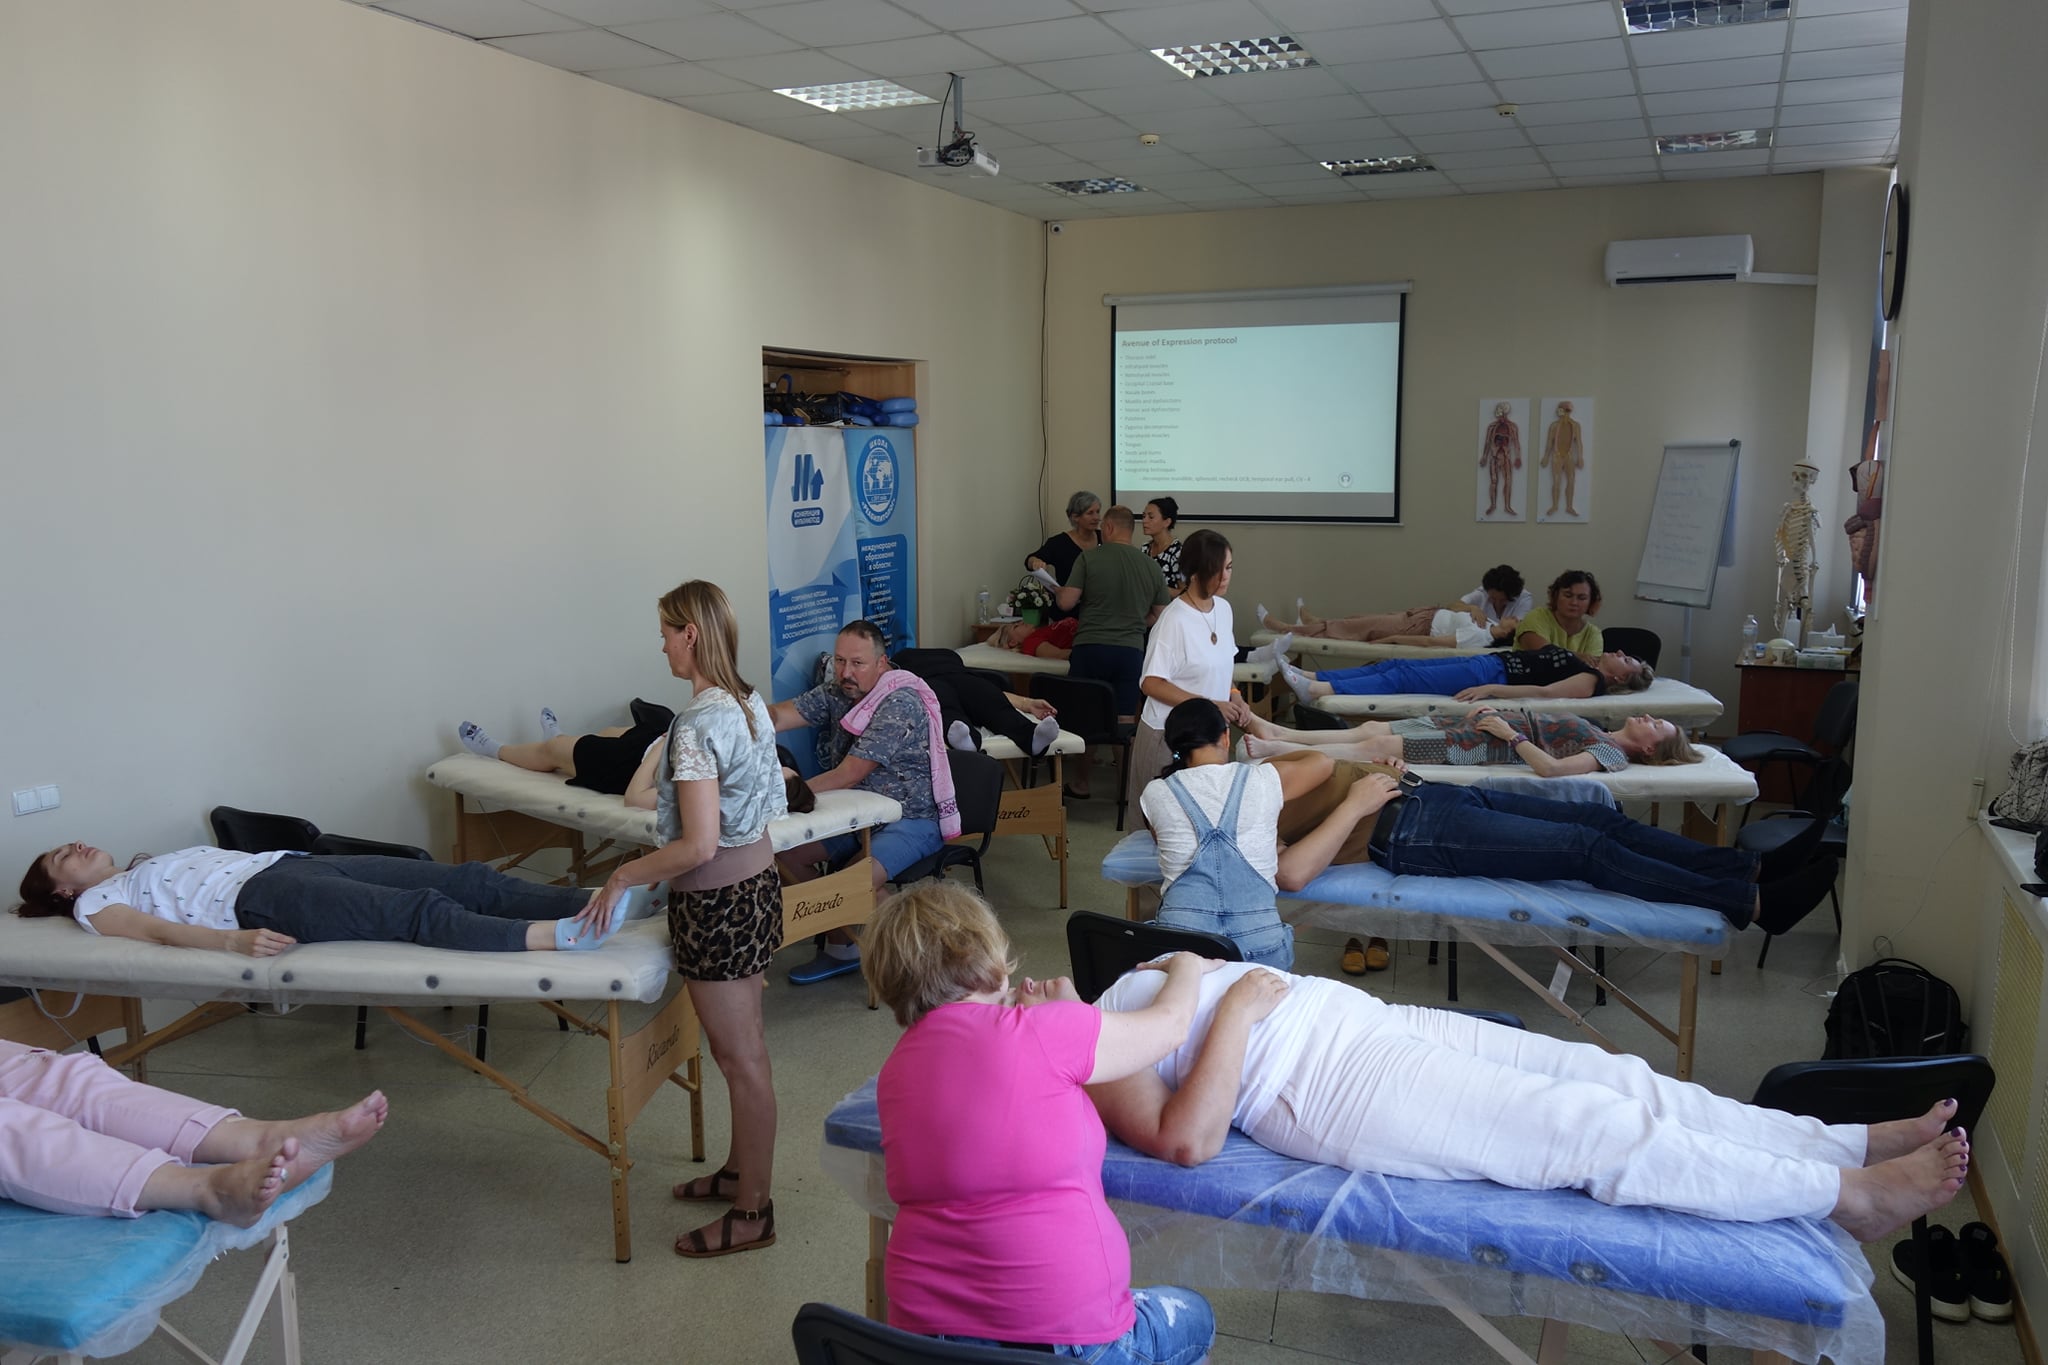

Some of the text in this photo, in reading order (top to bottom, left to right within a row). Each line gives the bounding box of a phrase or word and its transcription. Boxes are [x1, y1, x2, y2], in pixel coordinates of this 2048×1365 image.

[1122, 340, 1150, 348] Avenue
[1162, 338, 1203, 348] Expression
[1204, 337, 1238, 347] protocol
[999, 806, 1031, 820] ardo
[791, 893, 844, 921] Ricardo
[646, 1024, 680, 1073] Ricardo
